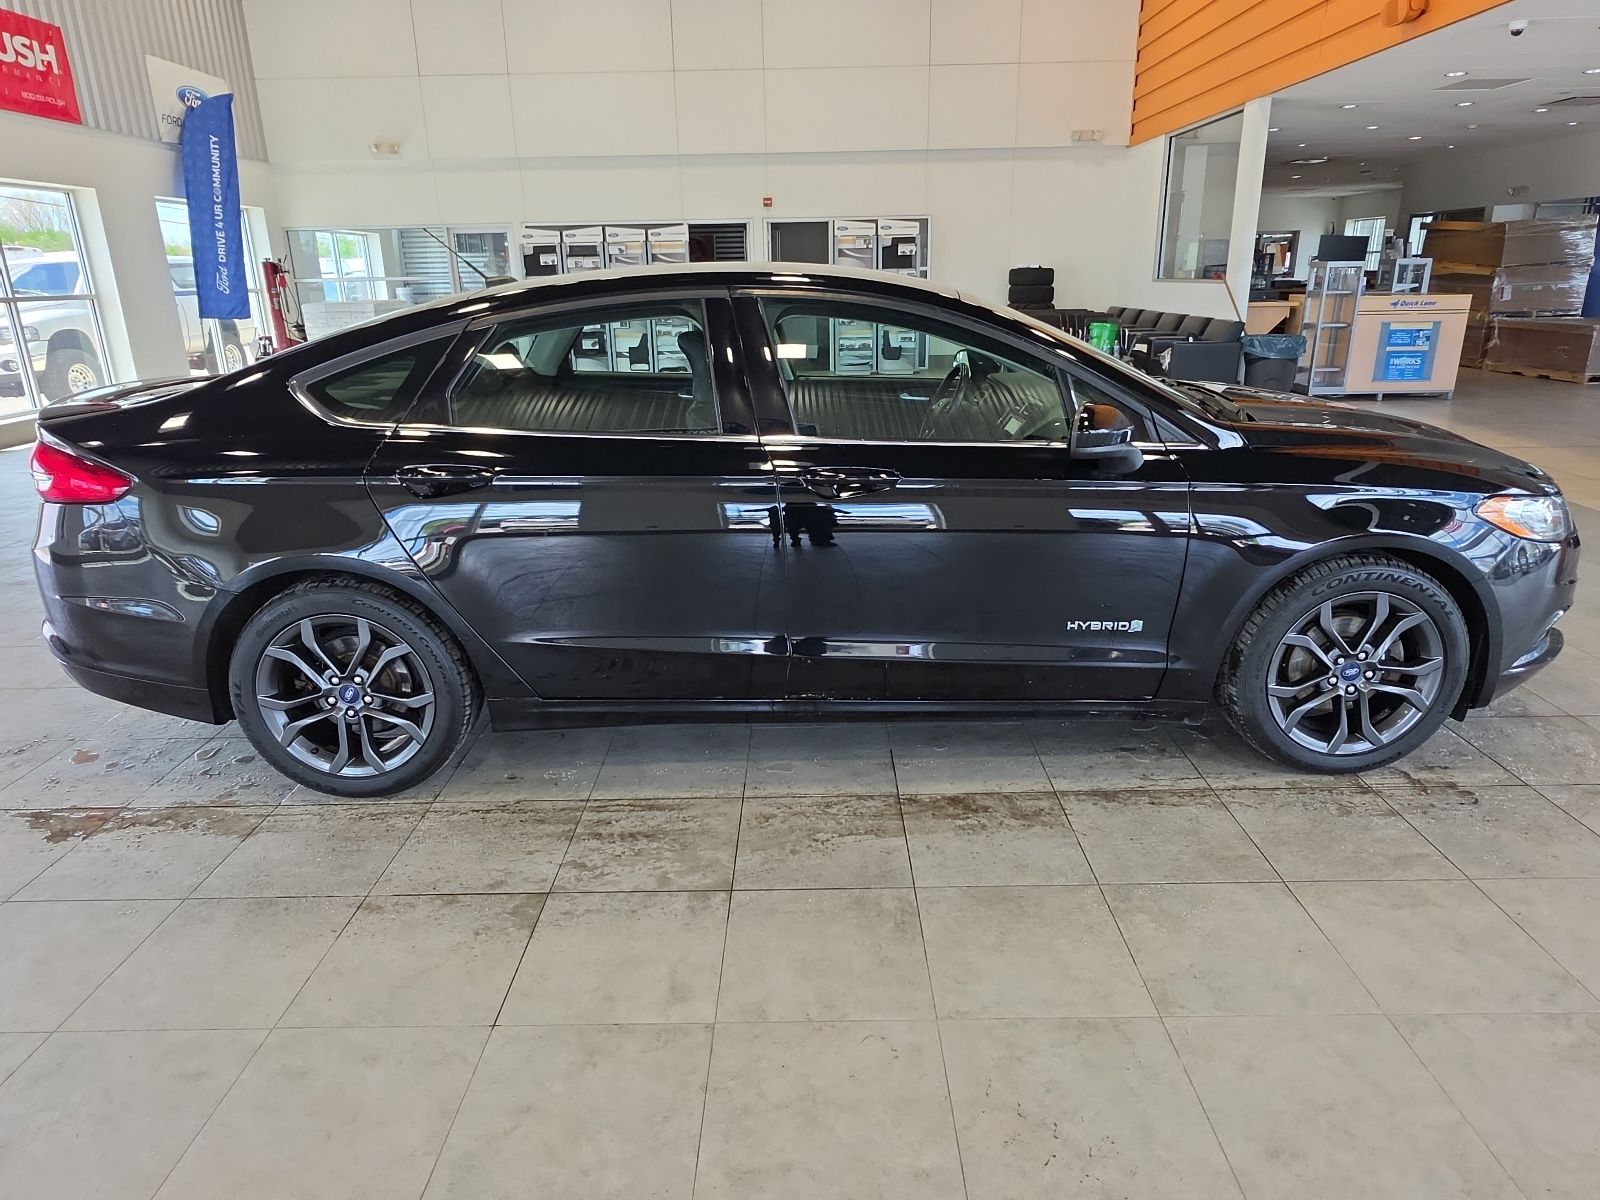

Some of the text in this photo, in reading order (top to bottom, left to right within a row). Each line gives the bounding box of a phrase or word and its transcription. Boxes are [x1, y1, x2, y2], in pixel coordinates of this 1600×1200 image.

[209, 134, 230, 295] Ford DRIVE 4 UR COMMUNITY
[1311, 572, 1454, 620] CONTINENTAL
[1066, 621, 1129, 631] HYBRID
